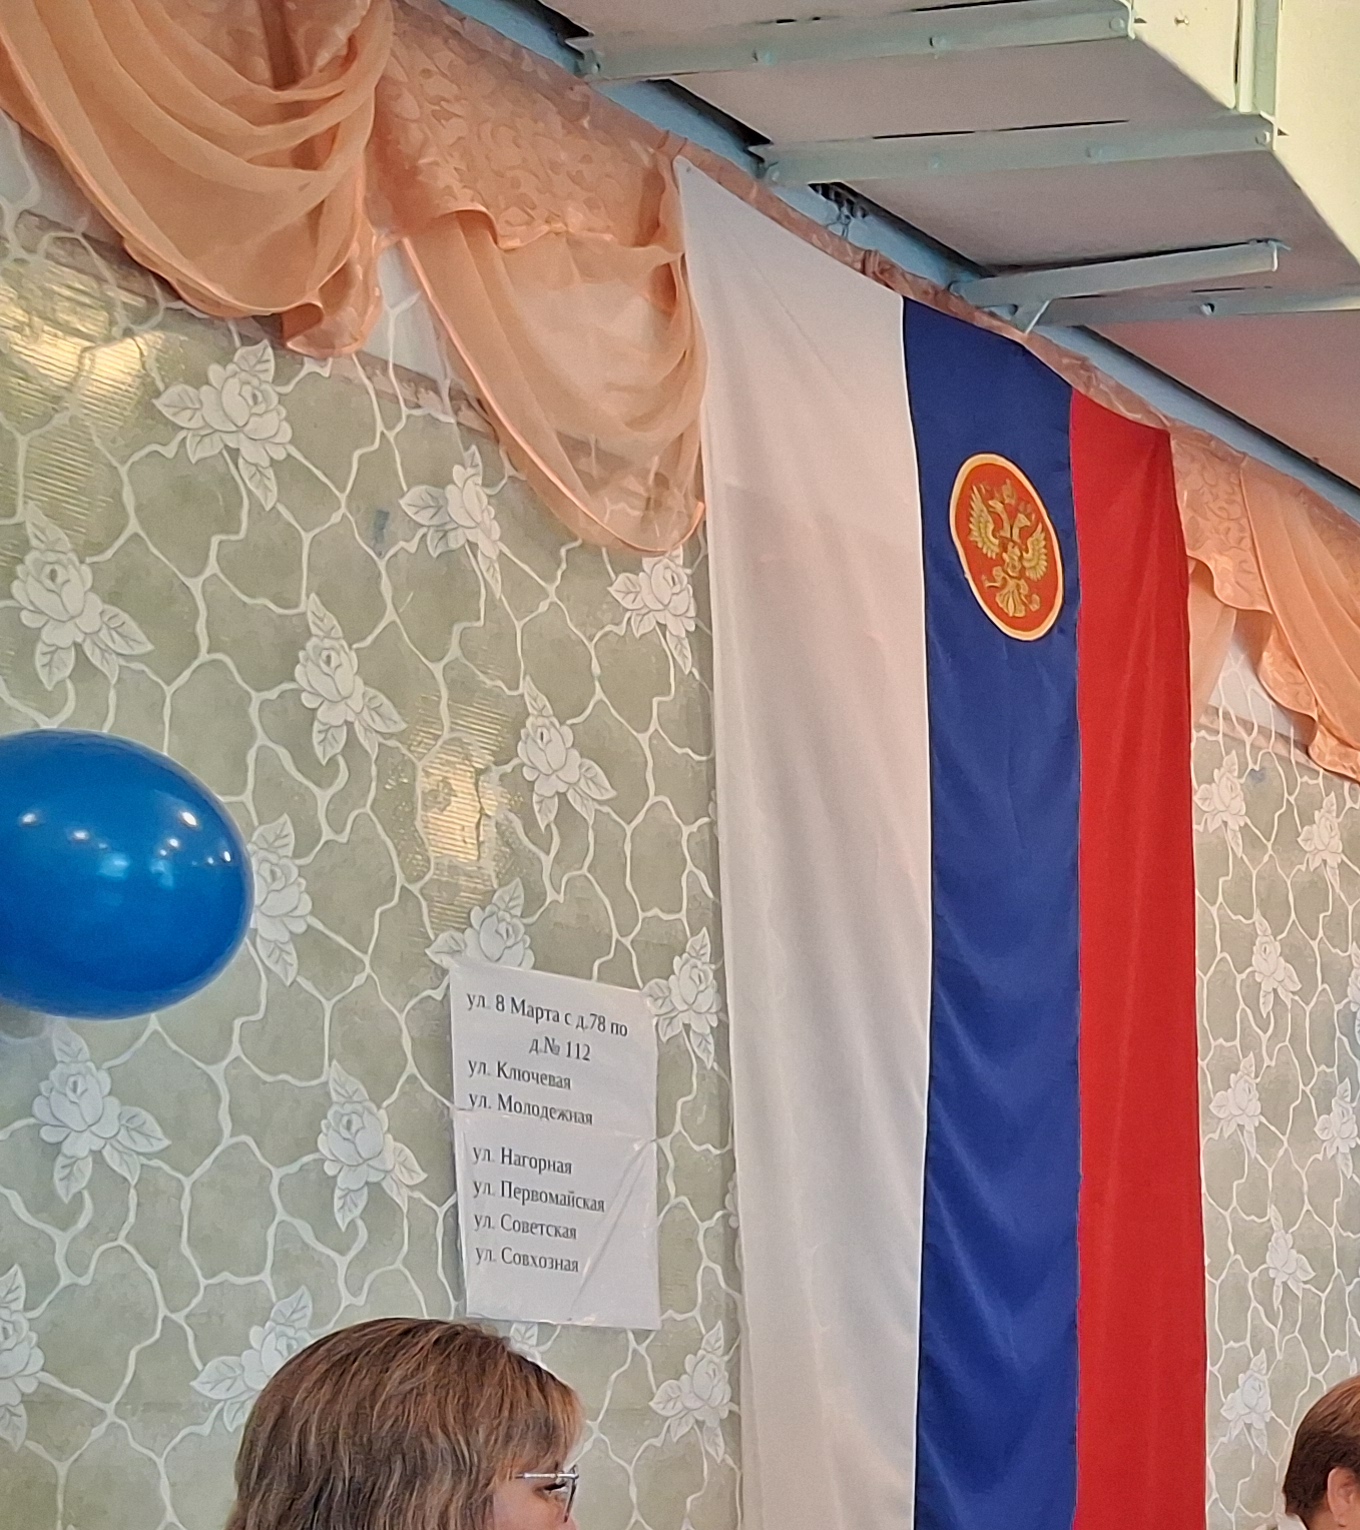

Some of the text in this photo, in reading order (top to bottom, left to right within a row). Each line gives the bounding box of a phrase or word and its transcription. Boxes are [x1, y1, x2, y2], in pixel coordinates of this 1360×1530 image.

[467, 993, 491, 1011] ул.
[495, 994, 505, 1012] 8
[510, 996, 560, 1024] Марта
[564, 1012, 572, 1026] с
[610, 1021, 628, 1037] по
[566, 1040, 591, 1061] 112
[468, 1060, 571, 1090] ул. Ключевая
[469, 1093, 593, 1125] ул. Молодежная
[473, 1146, 572, 1175] ул. Нагорная
[473, 1180, 605, 1213] ул. Первомайская
[474, 1213, 577, 1240] ул. Советская
[475, 1246, 579, 1273] ул. Совхозная
